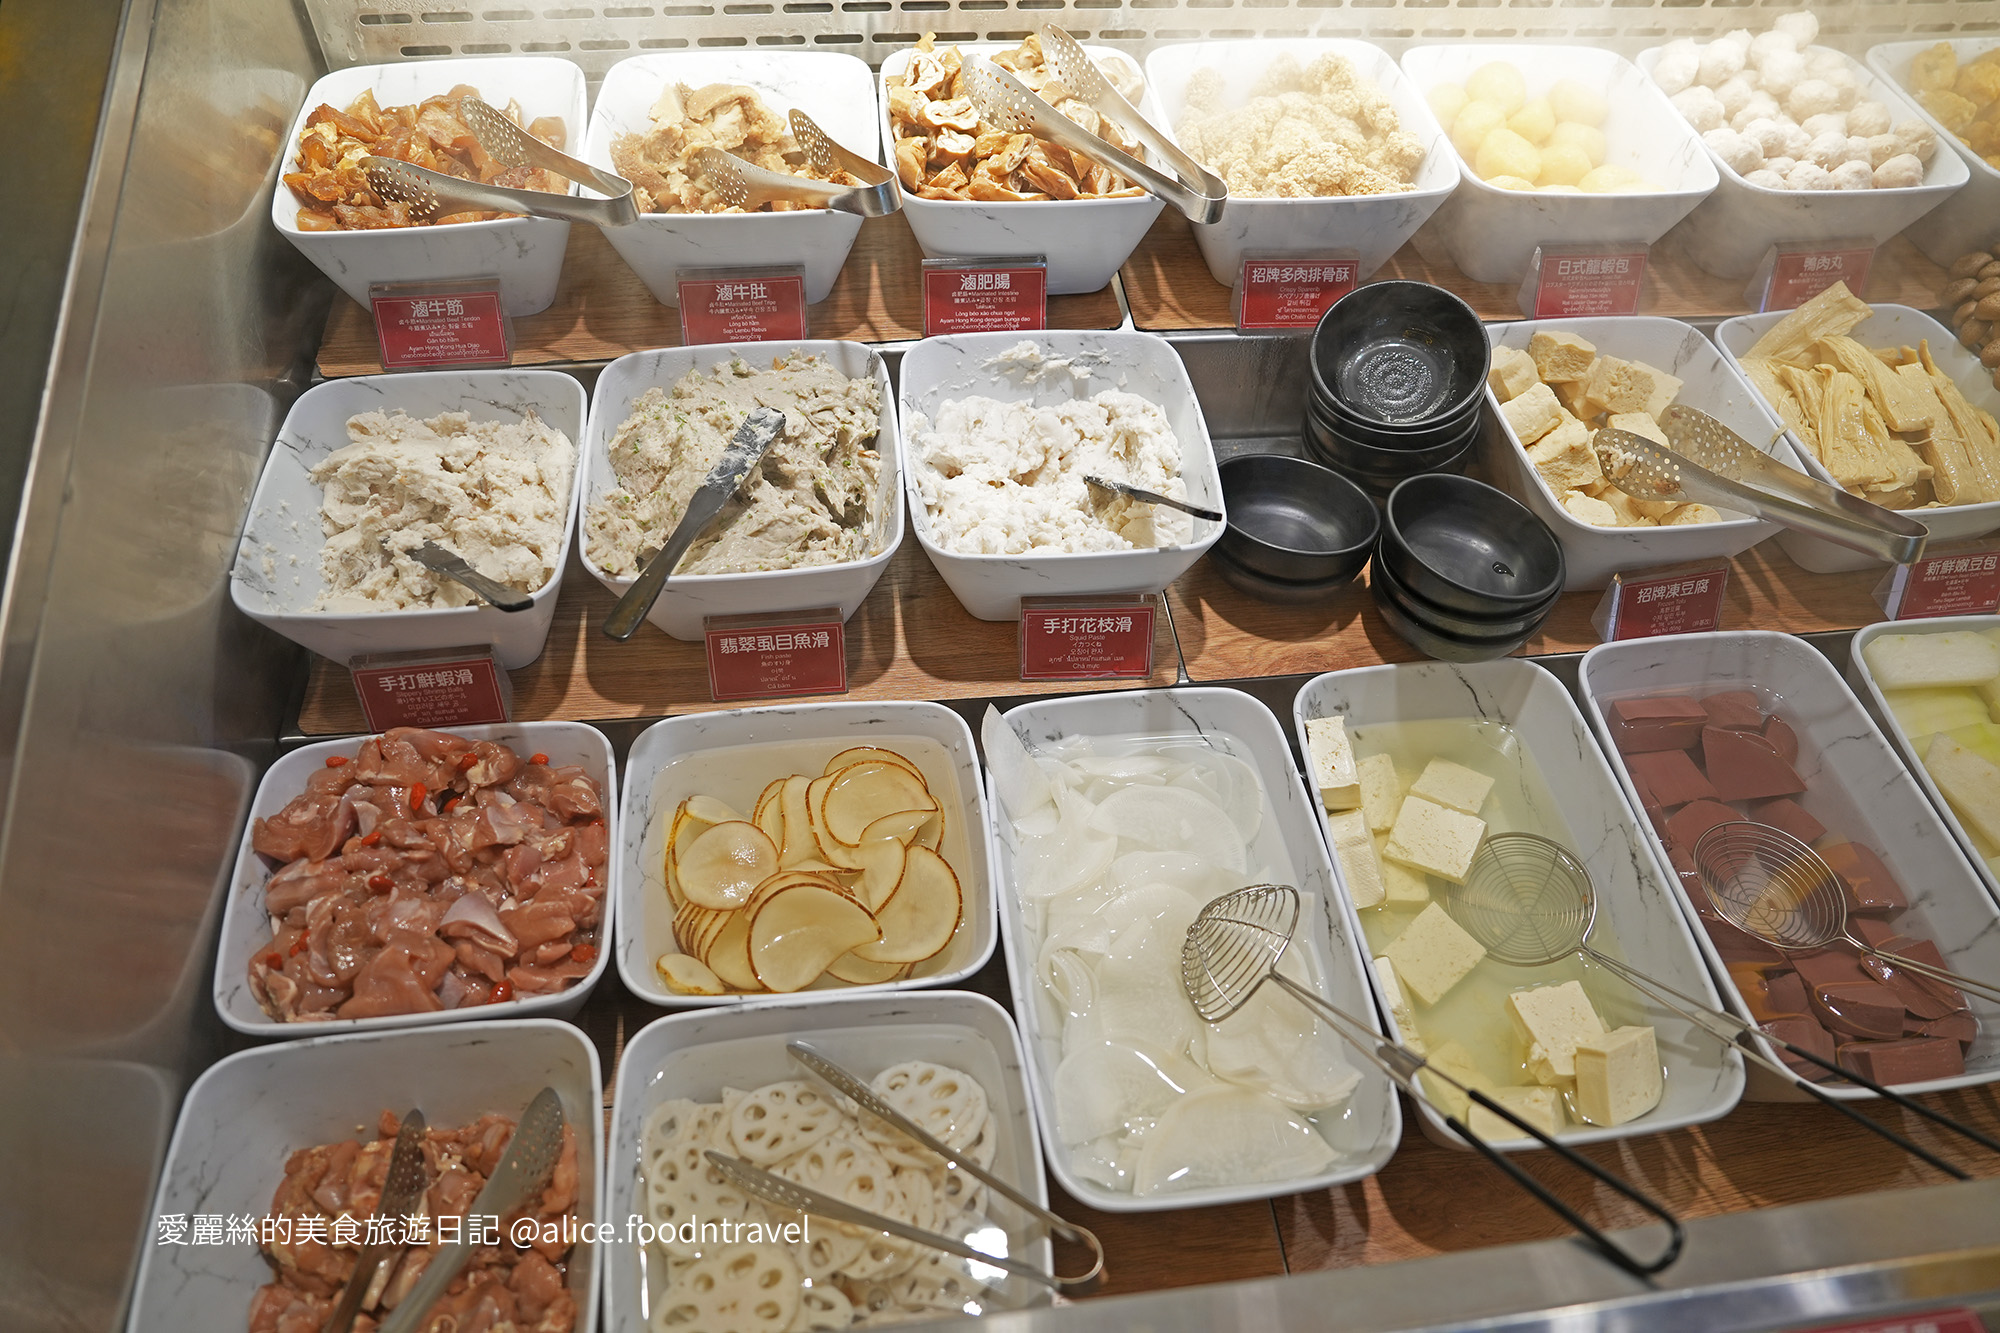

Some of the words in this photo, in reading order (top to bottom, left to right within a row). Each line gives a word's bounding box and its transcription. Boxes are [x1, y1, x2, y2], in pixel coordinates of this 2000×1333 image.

[1252, 267, 1350, 283] 招牌多肉排骨酥
[1558, 258, 1629, 275] 日式龍蝦包
[960, 274, 1010, 290] 滷肥腸
[716, 283, 767, 301] 滷牛肚
[411, 299, 464, 318] 滷牛筋
[1926, 556, 1998, 576] 新鮮嫩豆包
[1637, 578, 1710, 604] 招牌凍豆腐
[1043, 616, 1132, 634] 手打花枝滑
[720, 632, 830, 654] 翡翠虱目魚滑
[378, 668, 474, 692] 手打鮮蝦滑
